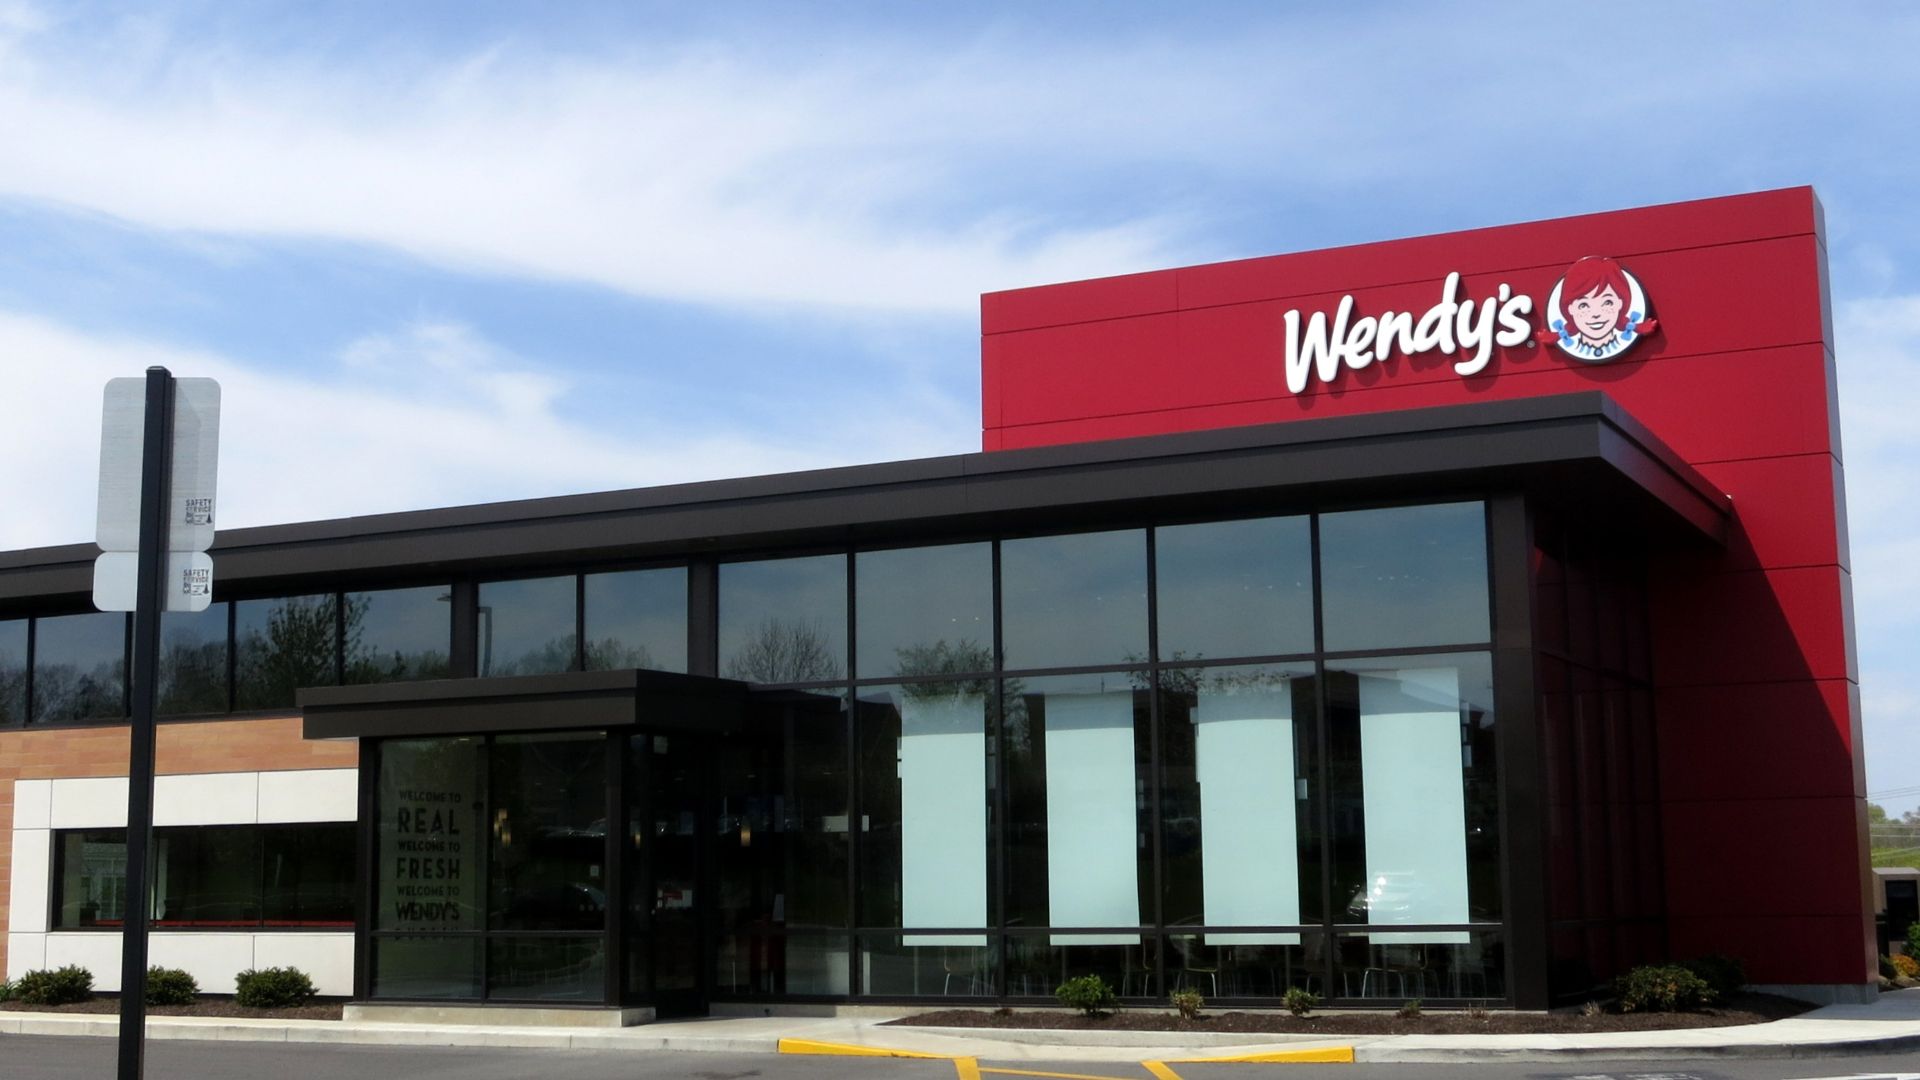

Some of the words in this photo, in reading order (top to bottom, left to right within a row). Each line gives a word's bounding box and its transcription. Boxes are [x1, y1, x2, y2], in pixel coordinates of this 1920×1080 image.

[1284, 272, 1532, 393] Wendy's
[185, 498, 212, 506] SAFETY
[183, 568, 209, 576] SAFETY
[399, 790, 446, 802] WELCOME
[448, 792, 461, 803] TO
[398, 807, 460, 835] REAL
[398, 840, 445, 852] WELCOME
[448, 841, 461, 853] TO
[396, 857, 460, 879] FRESH
[397, 885, 444, 896] WELCOME
[447, 885, 460, 896] TO
[395, 901, 460, 921] WENDY'S
